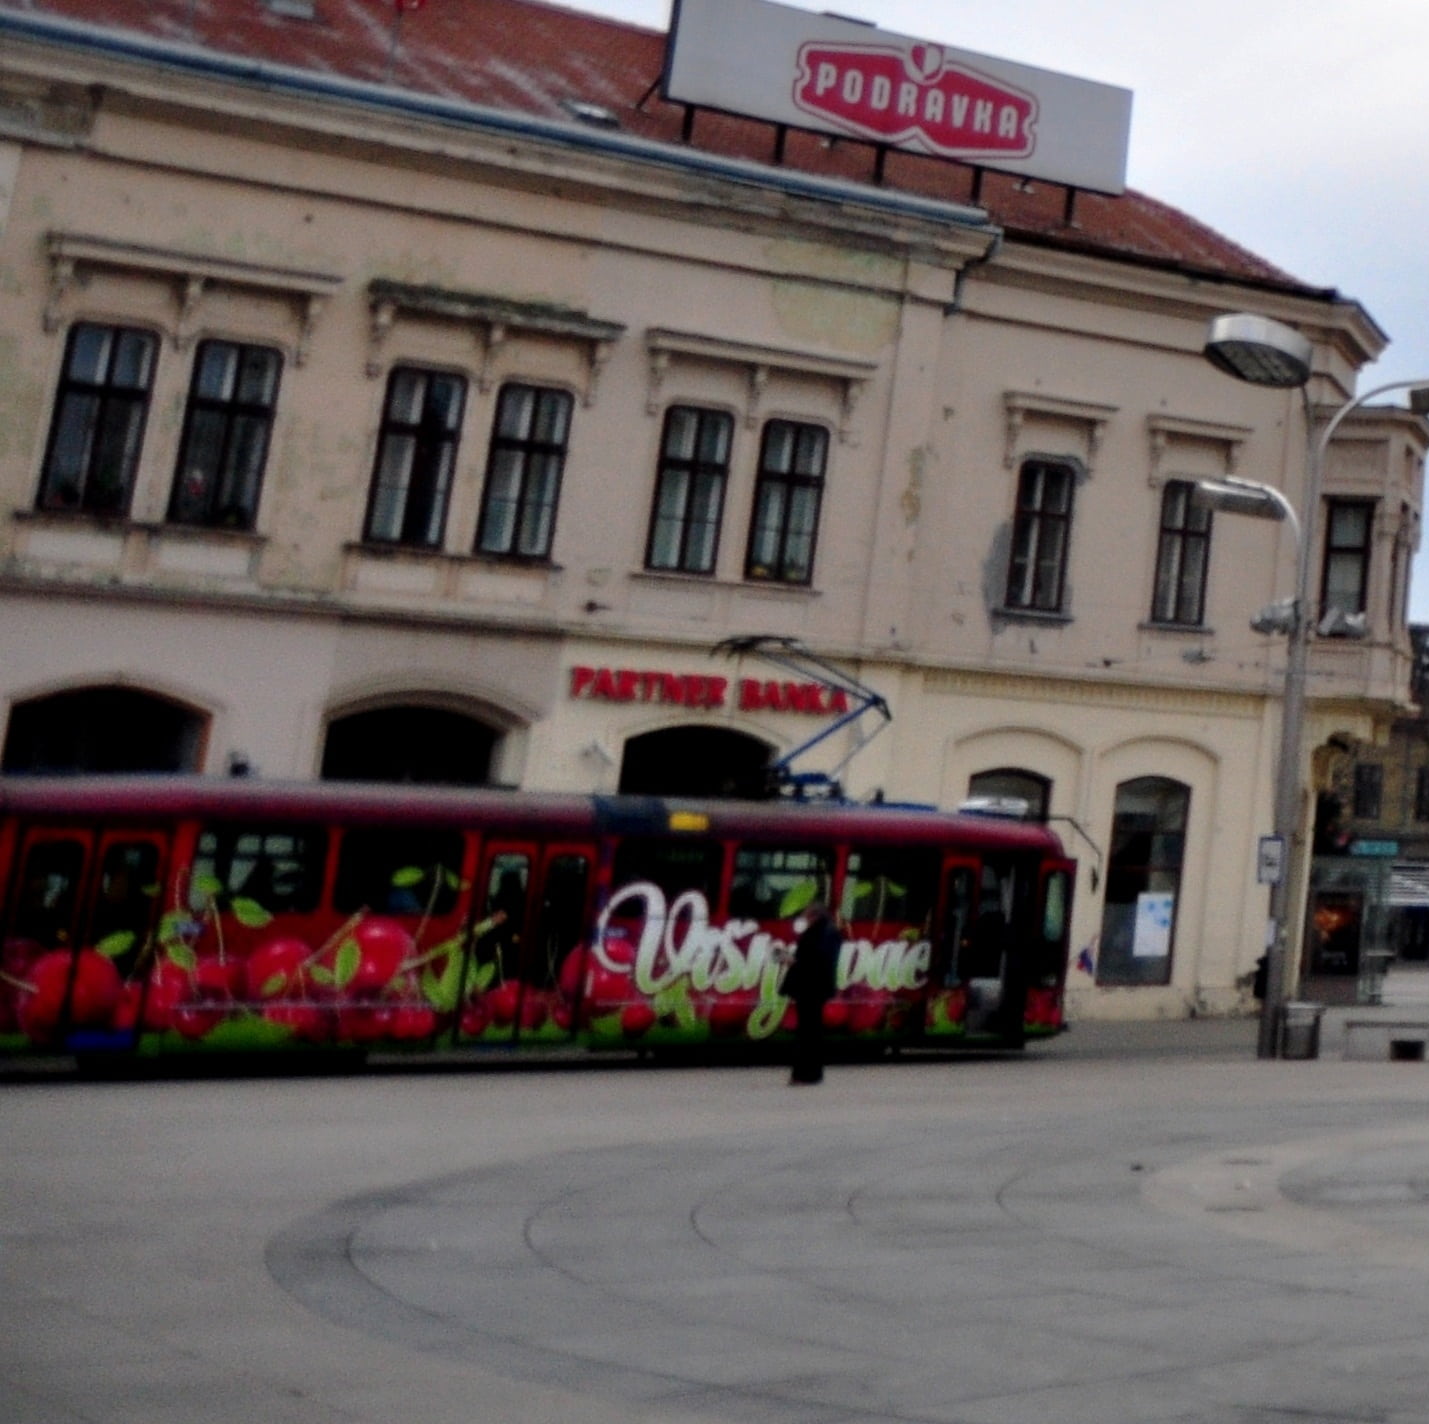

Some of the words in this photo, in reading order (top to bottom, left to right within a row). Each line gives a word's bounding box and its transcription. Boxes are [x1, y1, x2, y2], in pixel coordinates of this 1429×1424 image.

[814, 62, 1019, 139] PODRAVKA
[571, 666, 727, 710] PARTNER
[739, 678, 848, 713] BANKA
